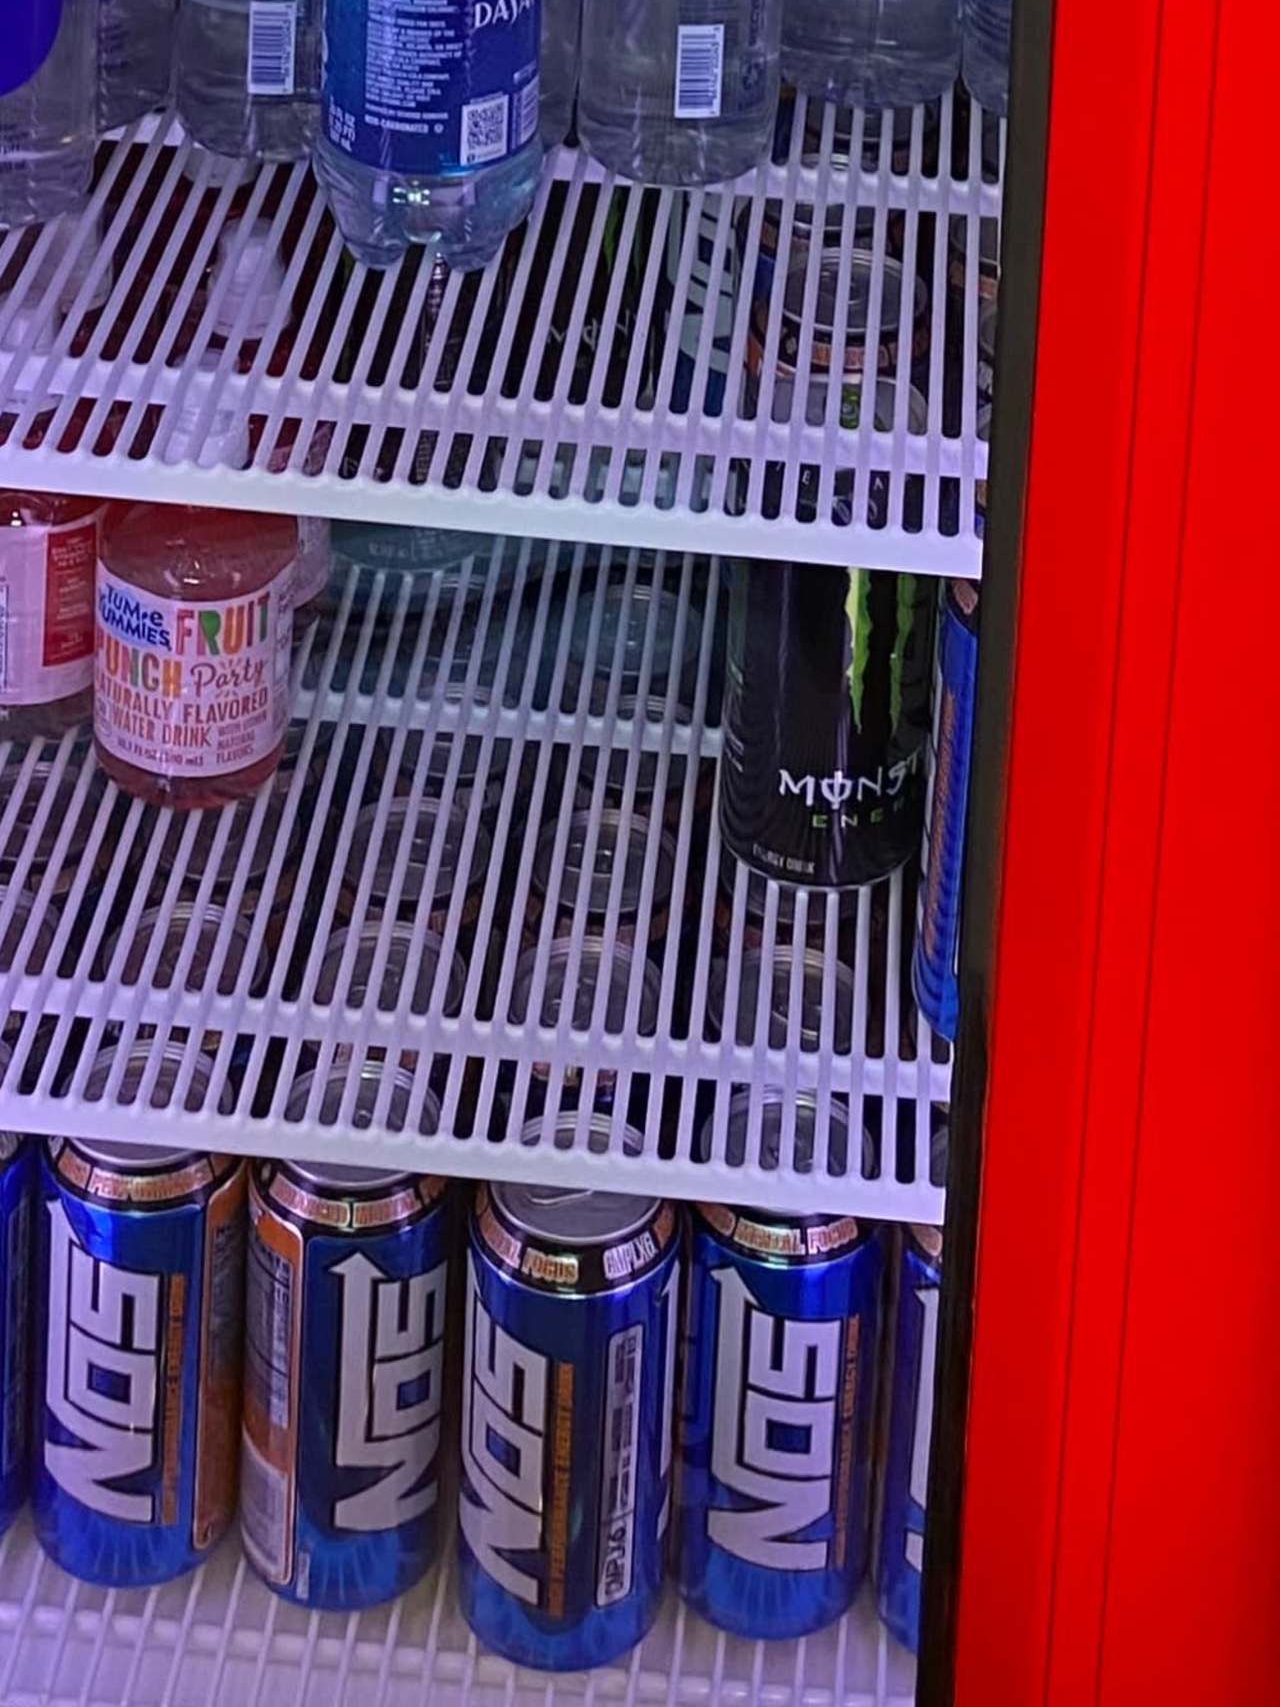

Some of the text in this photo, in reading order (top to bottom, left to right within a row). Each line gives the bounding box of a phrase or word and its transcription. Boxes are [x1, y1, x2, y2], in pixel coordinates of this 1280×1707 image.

[176, 591, 270, 656] FRUIT
[183, 686, 268, 724] FLAVORED
[190, 657, 268, 698] Party
[111, 701, 212, 748] WATER DRINK
[779, 750, 920, 810] MONST
[521, 1247, 579, 1284] FOCUS
[44, 1198, 160, 1524] NOS
[329, 1250, 448, 1532] NOS
[459, 1251, 551, 1606] NOS
[706, 1265, 842, 1572] NOS
